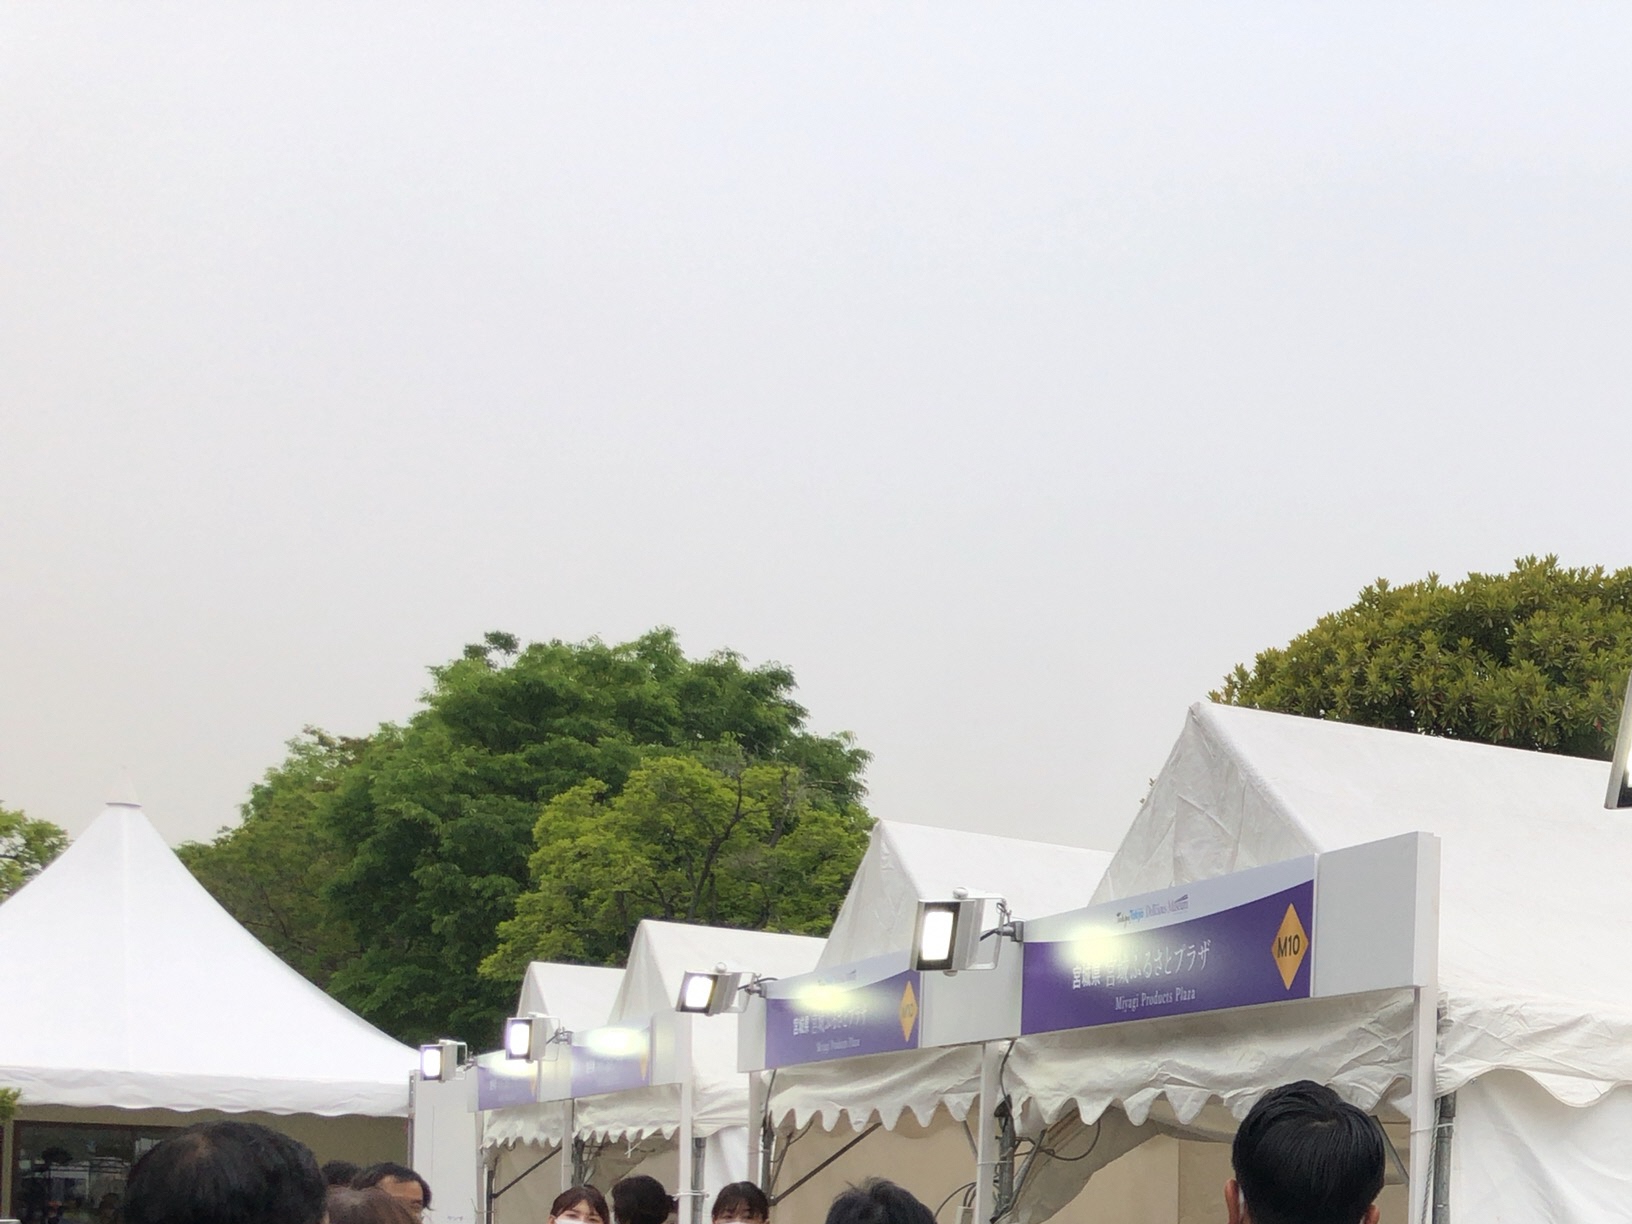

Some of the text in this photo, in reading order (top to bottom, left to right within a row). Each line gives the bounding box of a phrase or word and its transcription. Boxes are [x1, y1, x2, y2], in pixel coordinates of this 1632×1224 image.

[1277, 933, 1300, 959] M10
[1115, 987, 1196, 1012] Miyagi Products Plaza
